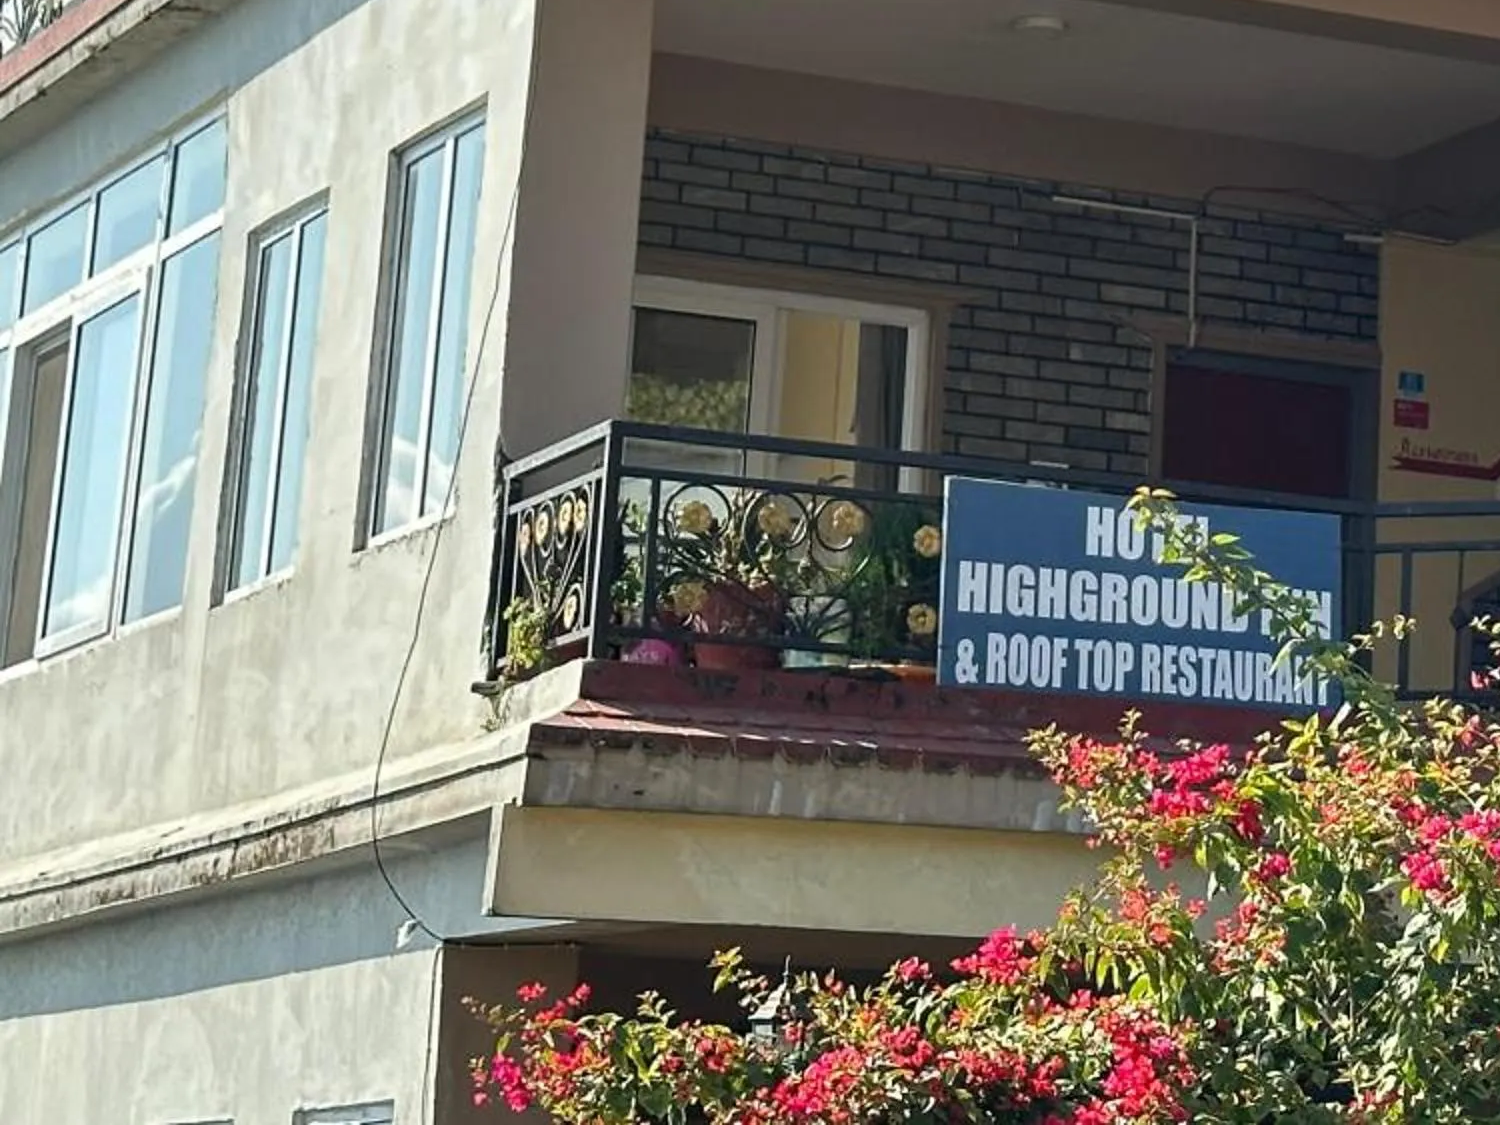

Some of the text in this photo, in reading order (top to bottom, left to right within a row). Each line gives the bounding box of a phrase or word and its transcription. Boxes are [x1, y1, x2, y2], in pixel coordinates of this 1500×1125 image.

[955, 638, 979, 684] &
[985, 632, 1068, 688] ROOF
[1073, 638, 1135, 692] TOP
